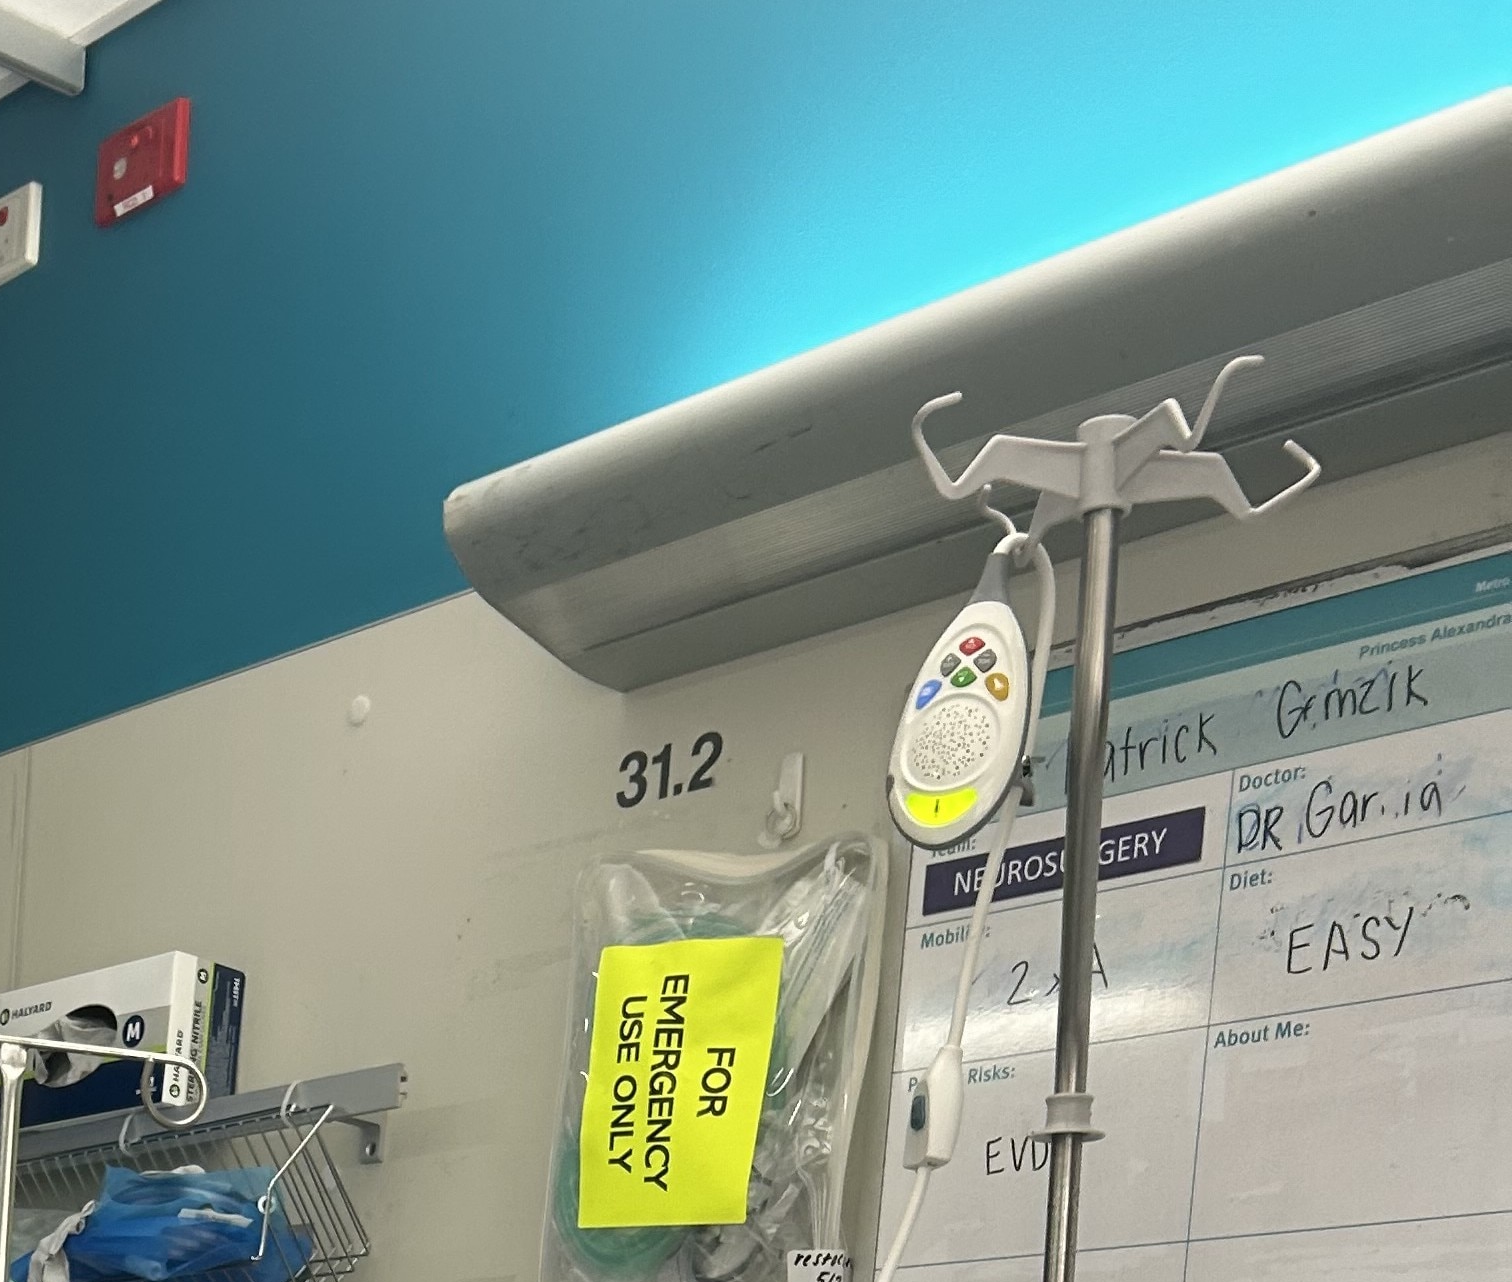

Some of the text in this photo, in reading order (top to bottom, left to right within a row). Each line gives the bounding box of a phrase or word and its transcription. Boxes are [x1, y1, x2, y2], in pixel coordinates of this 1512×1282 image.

[1359, 613, 1512, 659] Princess Alexandra
[616, 731, 724, 809] 31.2
[1065, 713, 1218, 795] atrick
[1239, 764, 1307, 793] Doctor:
[1236, 779, 1443, 855] DR Garia
[953, 827, 1168, 896] NEUROSGERY
[1229, 869, 1273, 891] Diet:
[920, 925, 991, 950] Mobili:
[1287, 906, 1415, 974] EASY
[1007, 960, 1032, 1005] 2
[11, 1001, 52, 1020] HALYARD
[126, 1023, 141, 1040] M
[191, 1000, 203, 1044] NITRILE
[1214, 1021, 1311, 1049] About Me:
[172, 1029, 184, 1084] HAARD
[607, 995, 648, 1174] USE ONLY
[643, 973, 690, 1192] EMERGENCY
[696, 1047, 736, 1118] FOR
